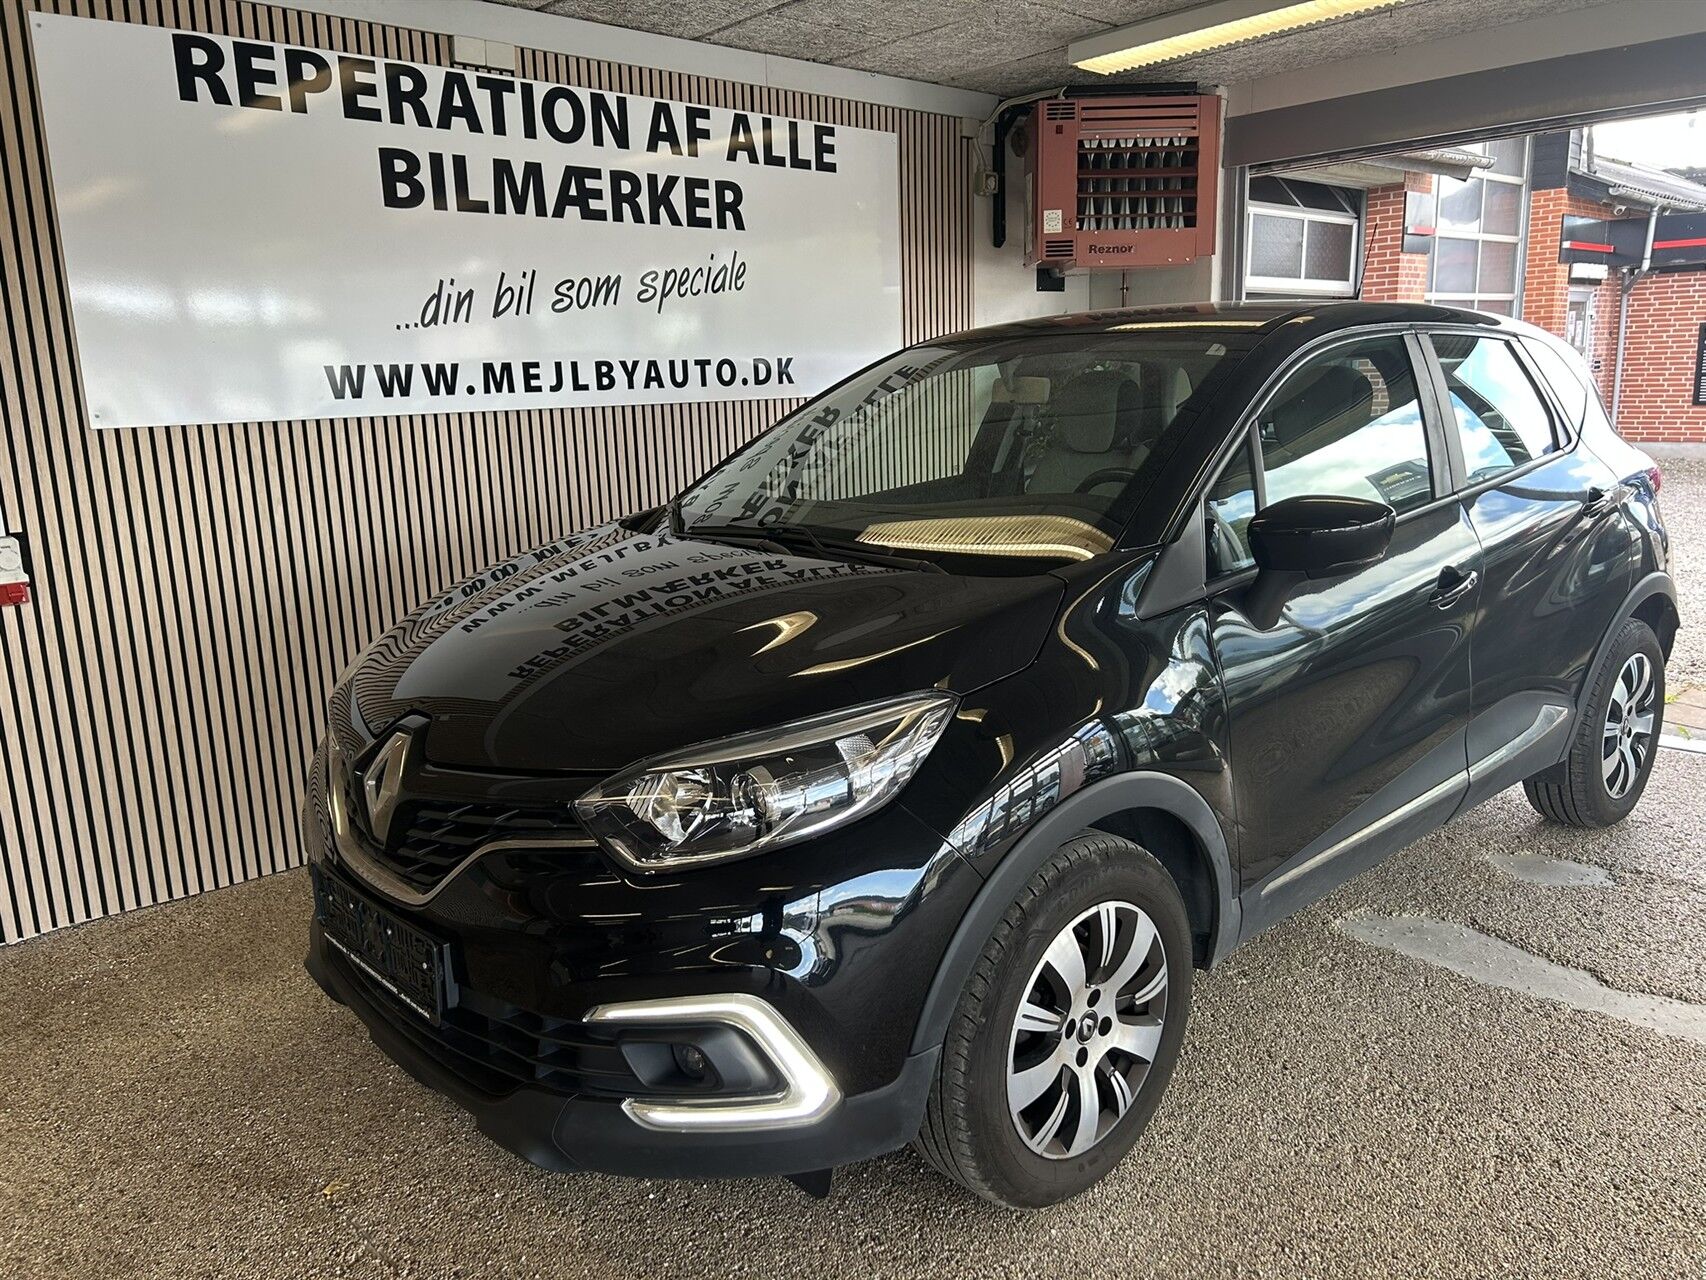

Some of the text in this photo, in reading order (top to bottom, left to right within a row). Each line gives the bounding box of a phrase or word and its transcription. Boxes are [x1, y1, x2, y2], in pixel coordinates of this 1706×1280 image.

[172, 33, 838, 174] REPERATION AF ALLE
[378, 147, 746, 231] BILMÆRKER
[1088, 244, 1134, 255] Reznor
[491, 269, 537, 318] bil
[550, 274, 622, 314] som
[636, 250, 747, 314] speciale
[324, 357, 796, 400] WWW.MEJLBYAUTO.DK
